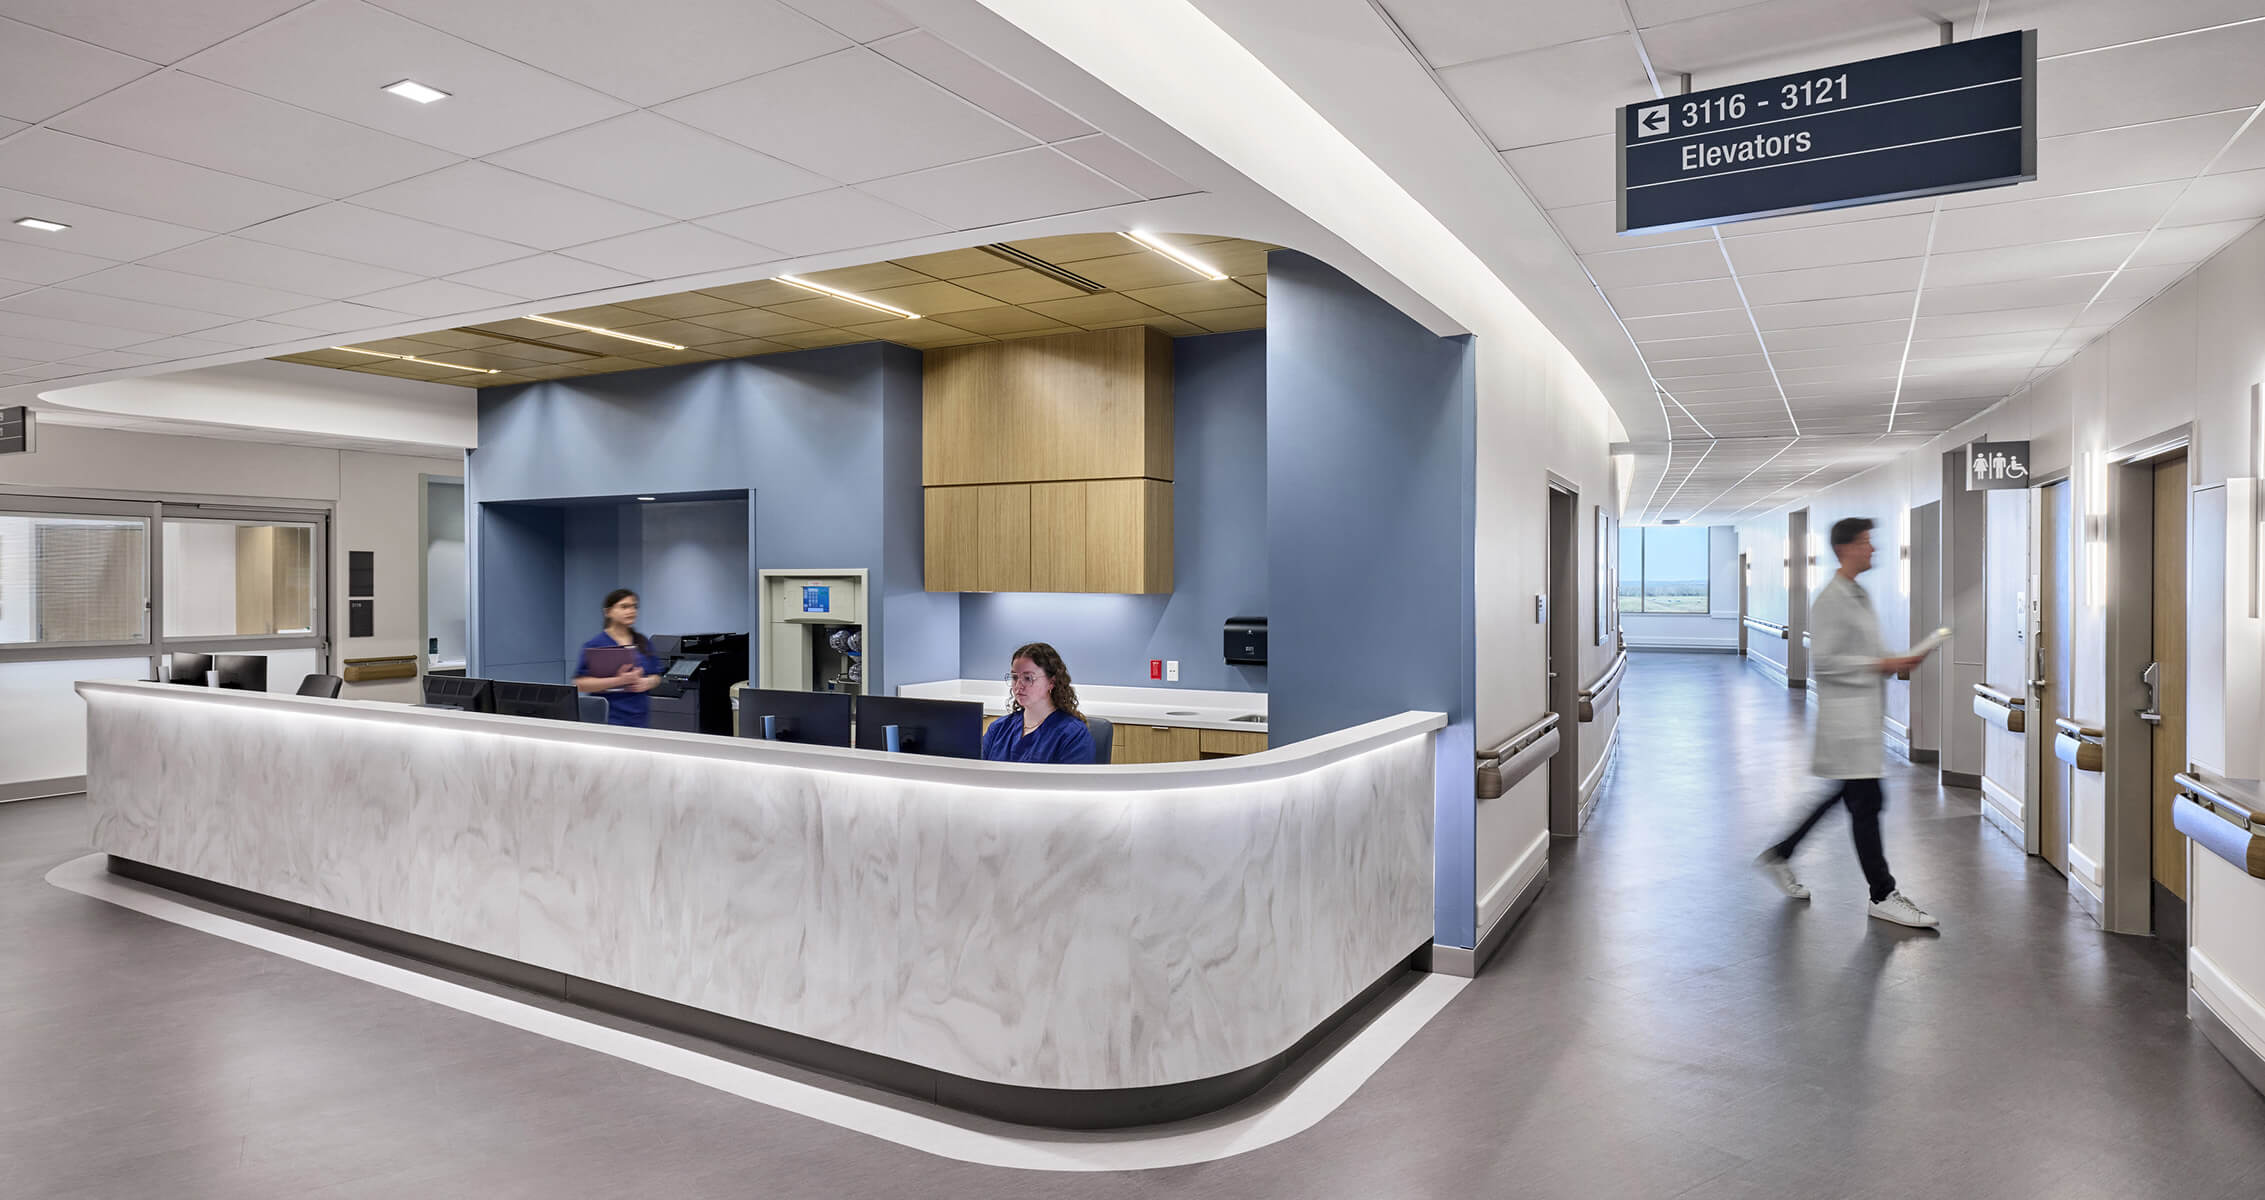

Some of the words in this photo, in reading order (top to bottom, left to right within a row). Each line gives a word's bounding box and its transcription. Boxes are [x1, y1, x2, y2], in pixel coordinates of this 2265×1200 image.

[1682, 94, 1746, 127] 3116
[1780, 74, 1847, 109] 3121
[1682, 132, 1812, 170] Elevators
